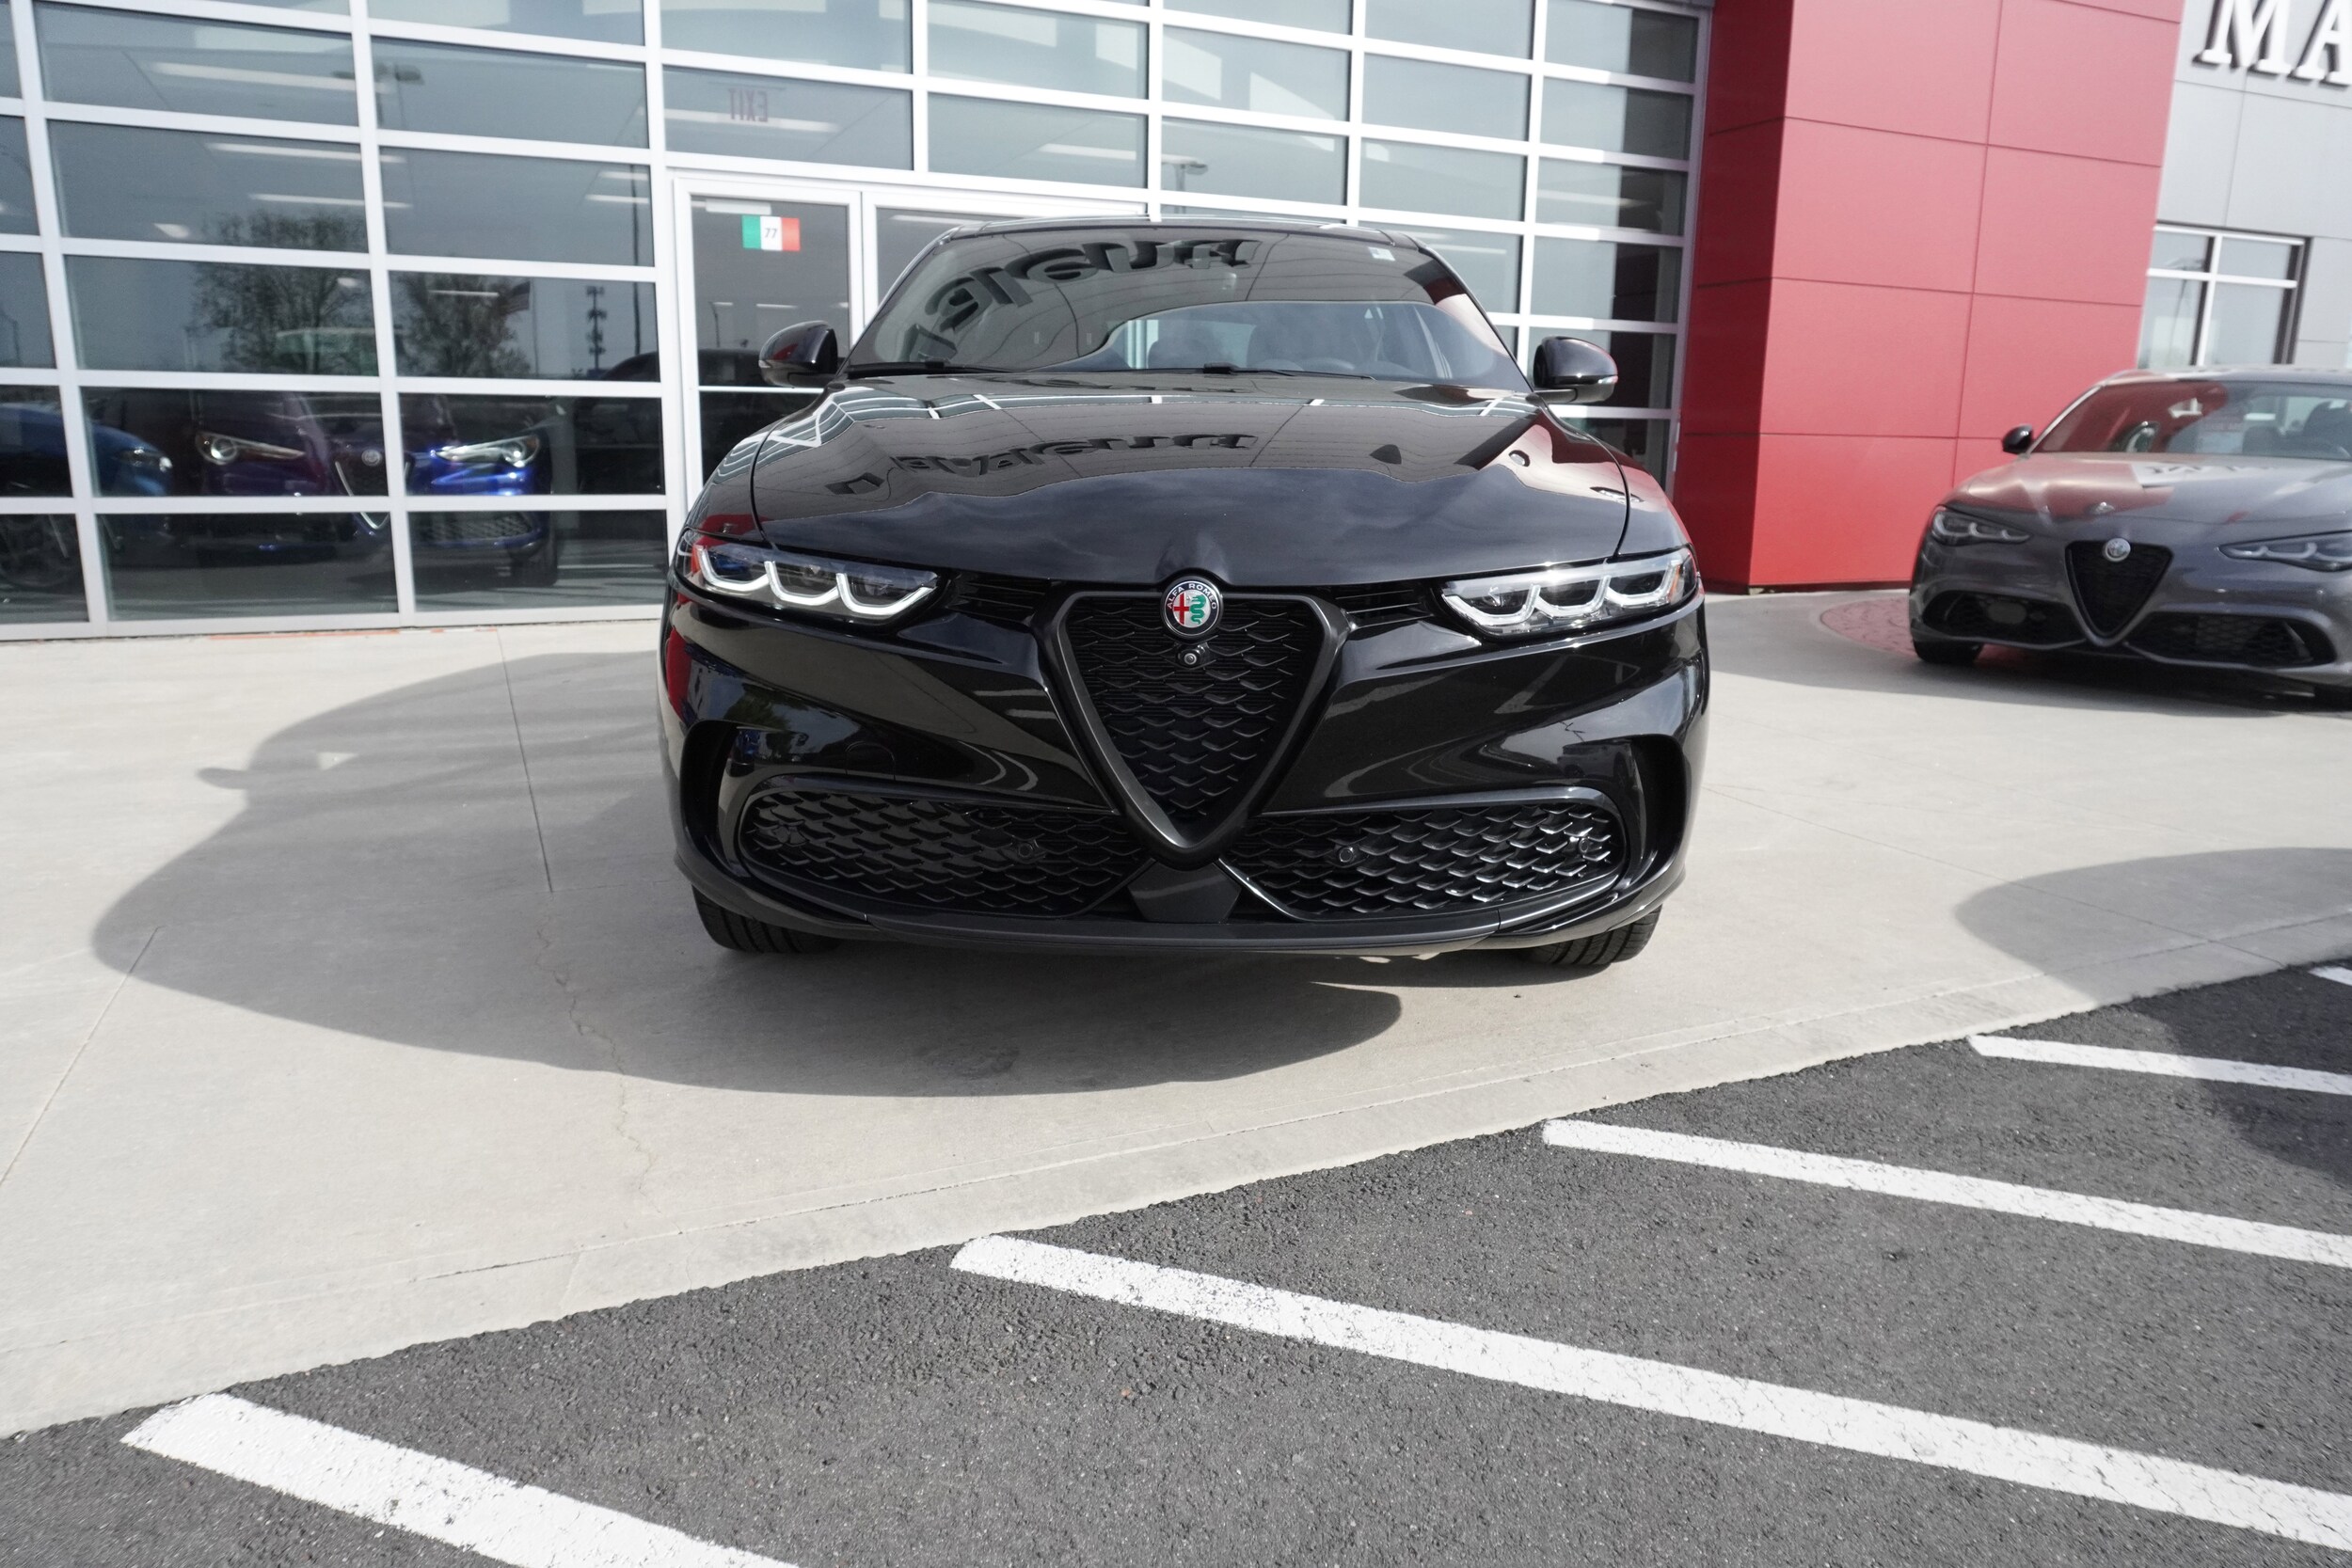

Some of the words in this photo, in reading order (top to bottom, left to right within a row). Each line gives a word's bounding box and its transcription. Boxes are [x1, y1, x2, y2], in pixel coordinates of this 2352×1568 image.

[764, 228, 778, 239] 77
[1167, 586, 1184, 610] ALFA
[1188, 582, 1217, 610] ROMEO
